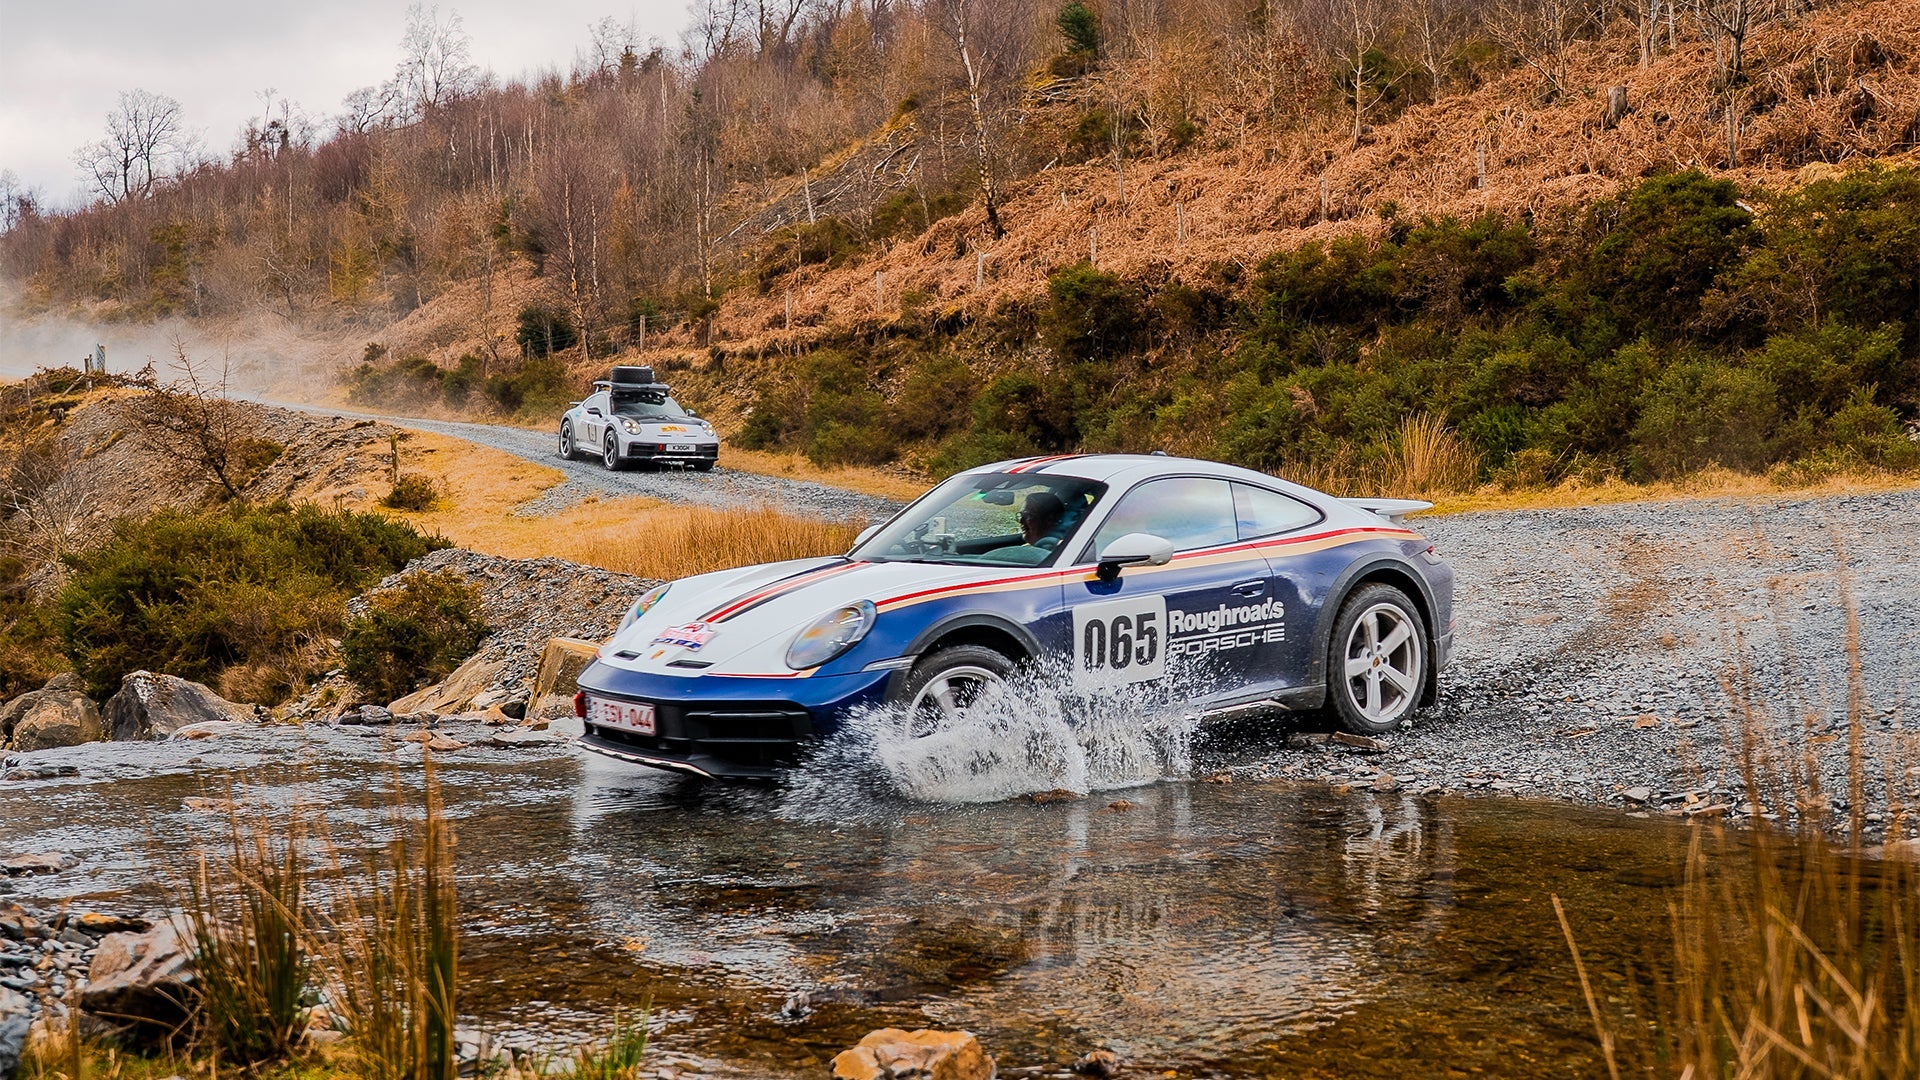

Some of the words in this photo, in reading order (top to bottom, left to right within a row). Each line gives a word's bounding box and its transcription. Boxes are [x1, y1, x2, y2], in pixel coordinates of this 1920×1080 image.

[1169, 597, 1284, 634] Roughroads
[1084, 612, 1158, 671] 065
[1168, 627, 1285, 656] PORSCHE
